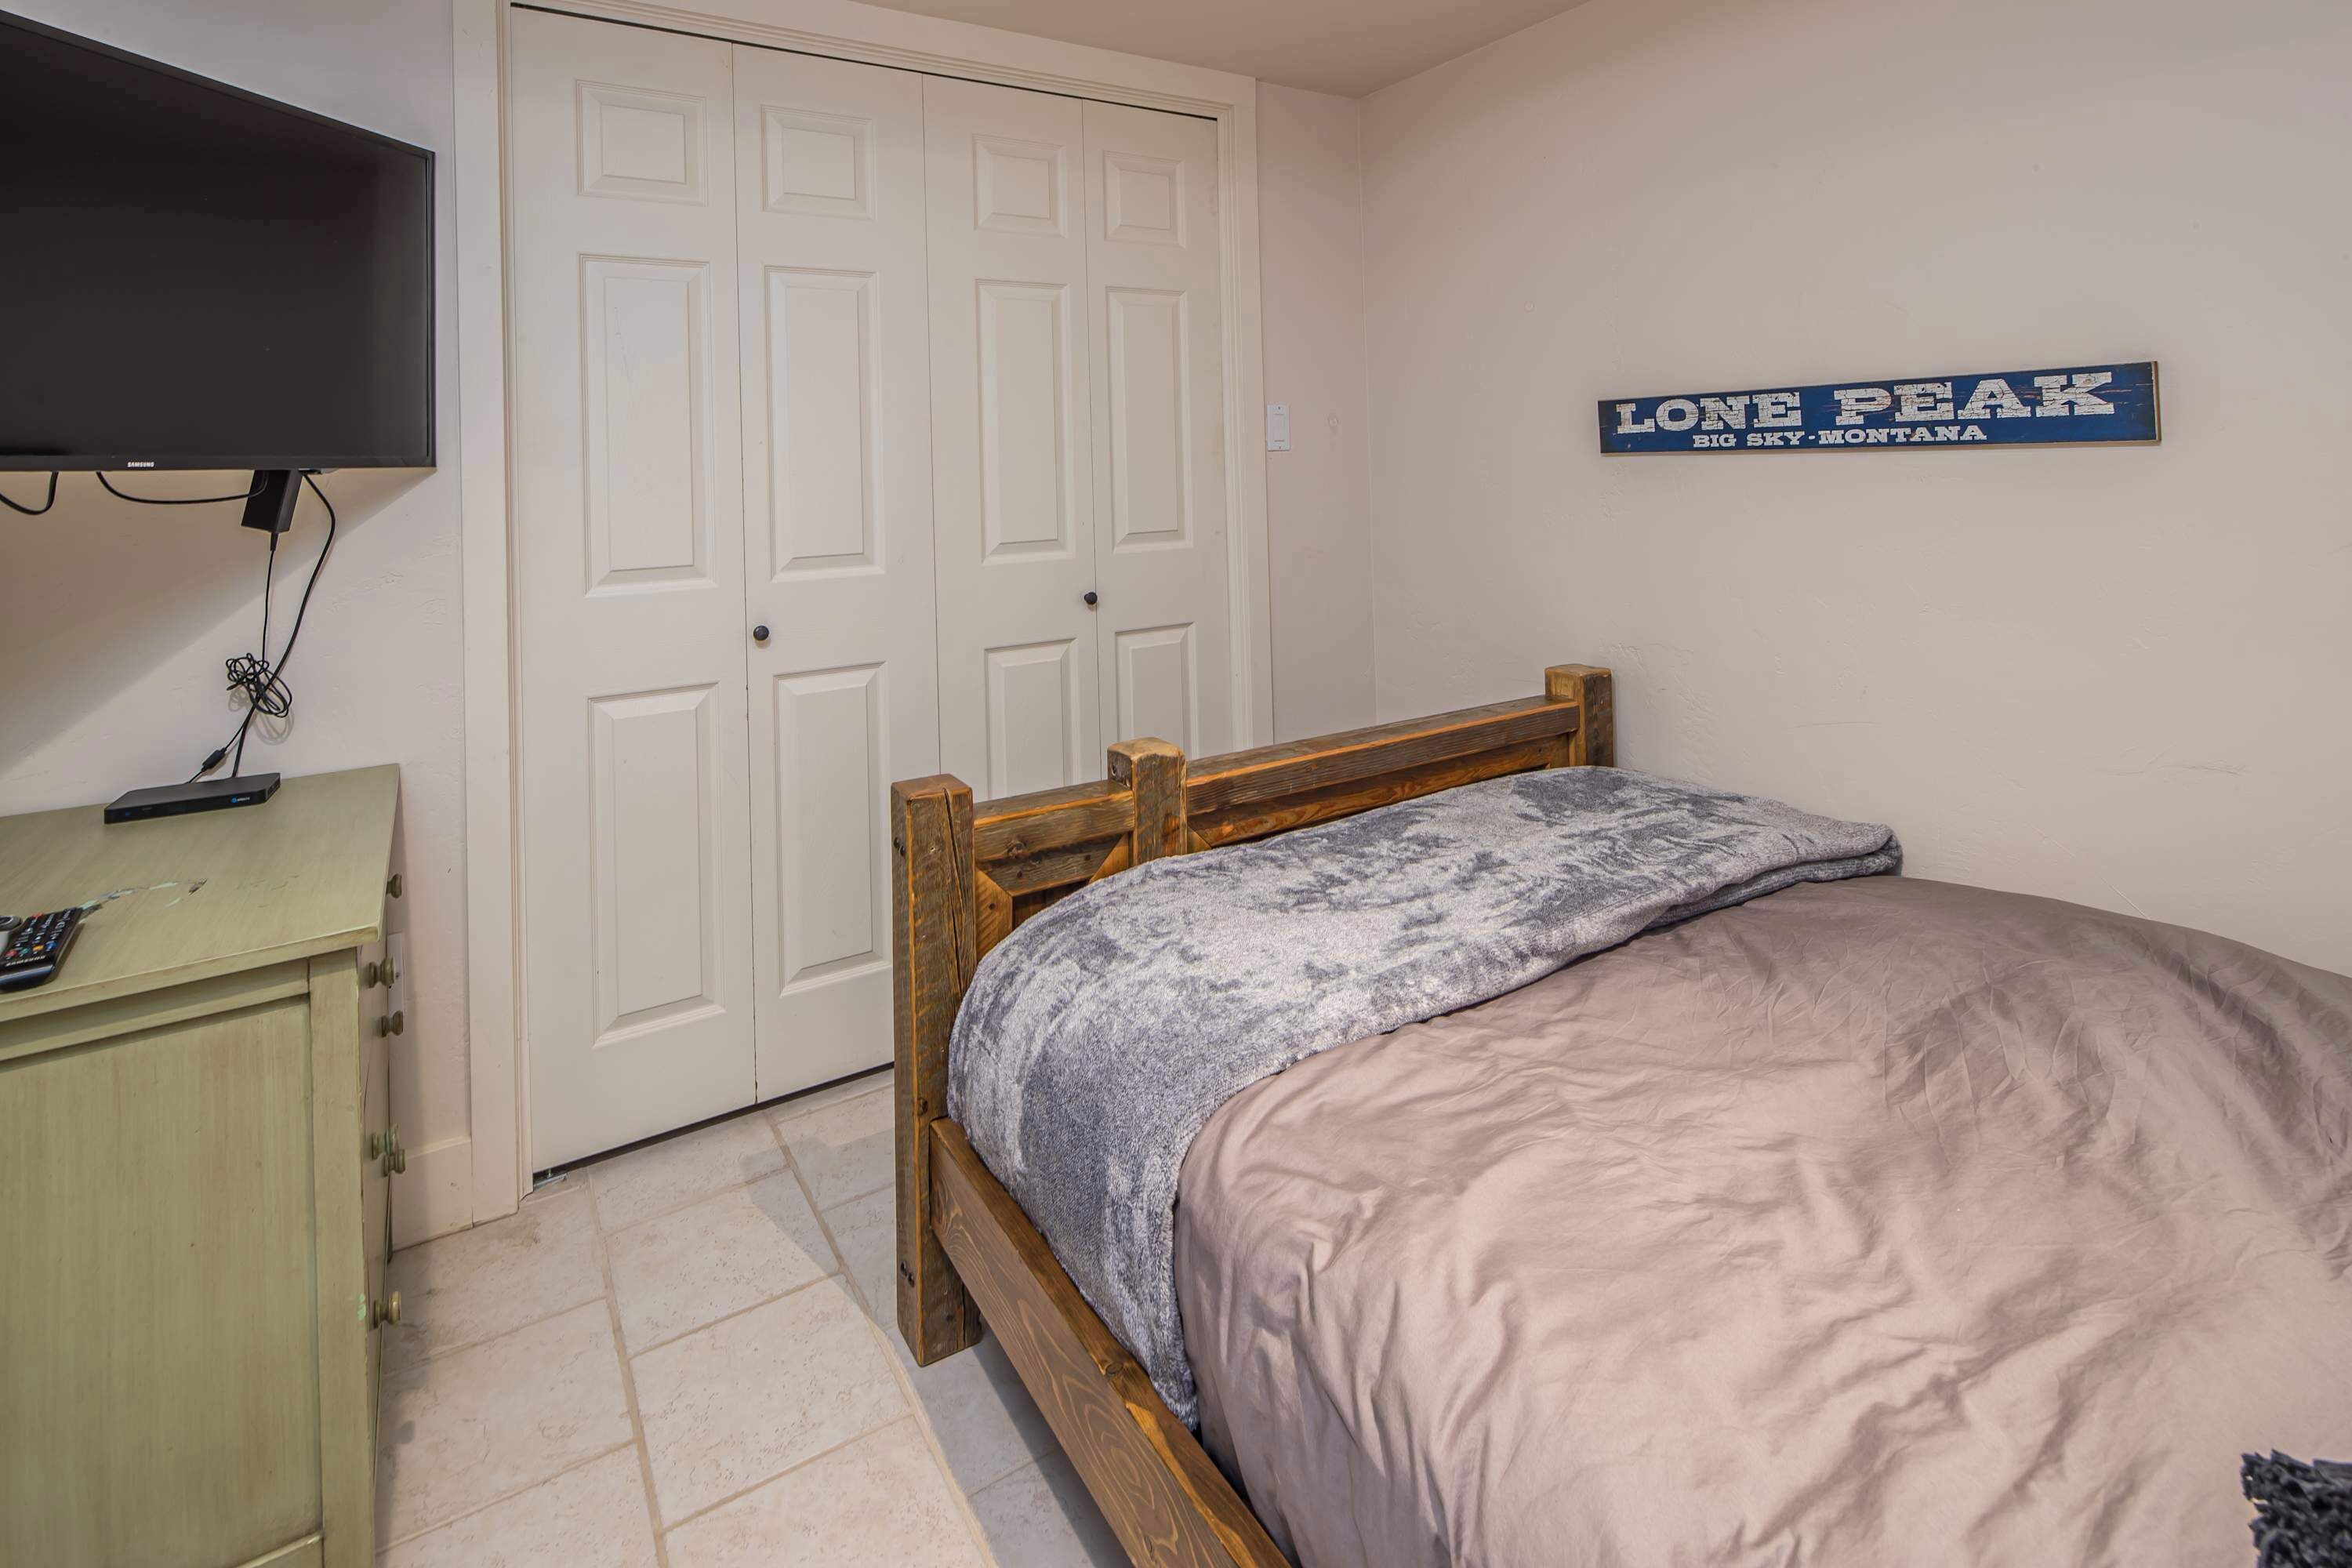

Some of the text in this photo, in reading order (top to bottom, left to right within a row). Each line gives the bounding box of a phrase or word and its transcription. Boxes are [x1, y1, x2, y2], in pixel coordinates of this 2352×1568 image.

[1615, 371, 2115, 434] LONE PEAK
[1692, 433, 1737, 448] BIG
